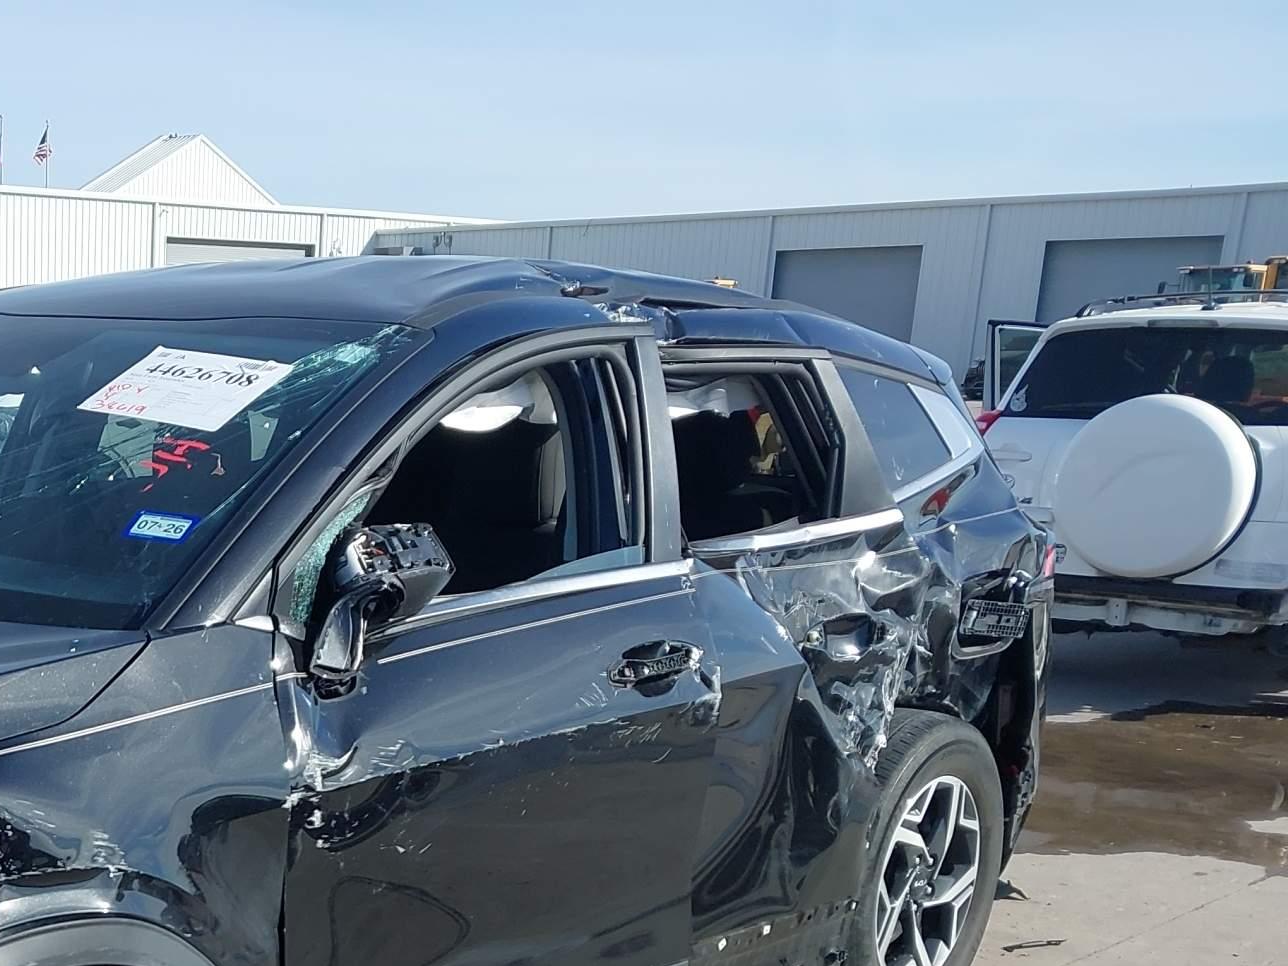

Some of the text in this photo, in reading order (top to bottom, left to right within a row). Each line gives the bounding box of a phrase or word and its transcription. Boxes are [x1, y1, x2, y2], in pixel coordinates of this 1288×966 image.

[146, 362, 260, 387] 44626708
[136, 519, 186, 535] 07 26
